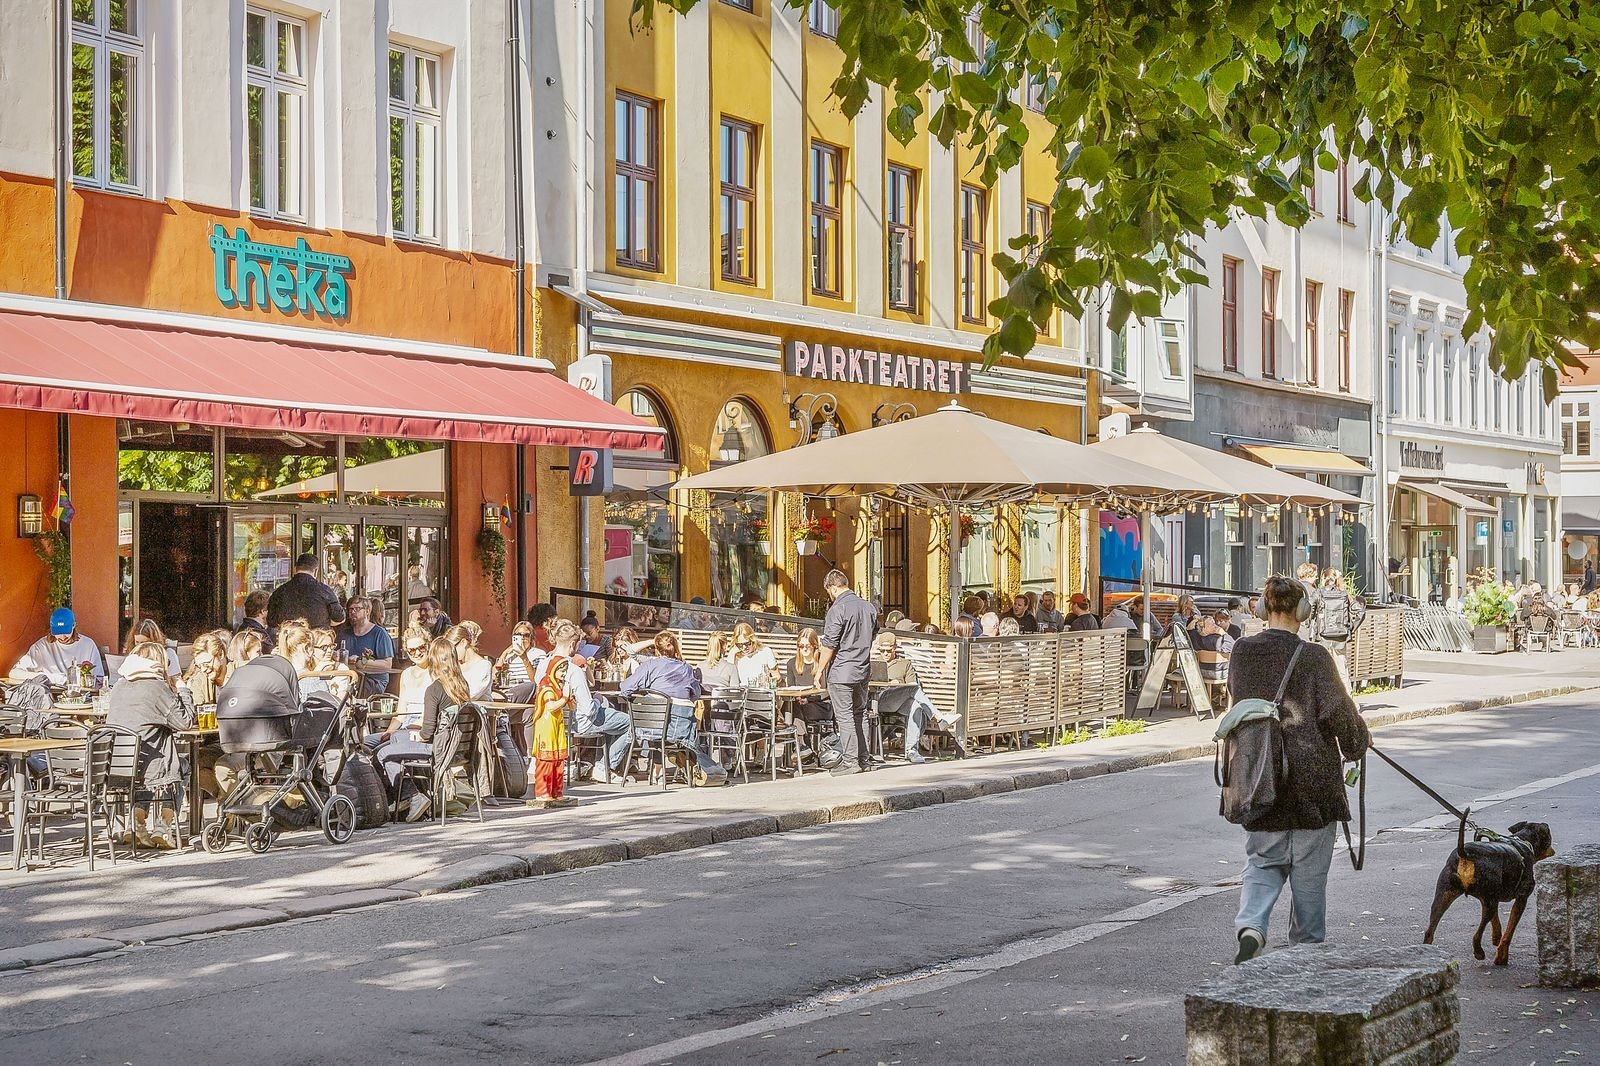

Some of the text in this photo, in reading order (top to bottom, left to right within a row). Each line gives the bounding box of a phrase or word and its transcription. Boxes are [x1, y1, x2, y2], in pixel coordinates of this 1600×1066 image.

[209, 224, 352, 320] theka
[794, 341, 964, 394] PARKTEATRET
[573, 450, 598, 484] R
